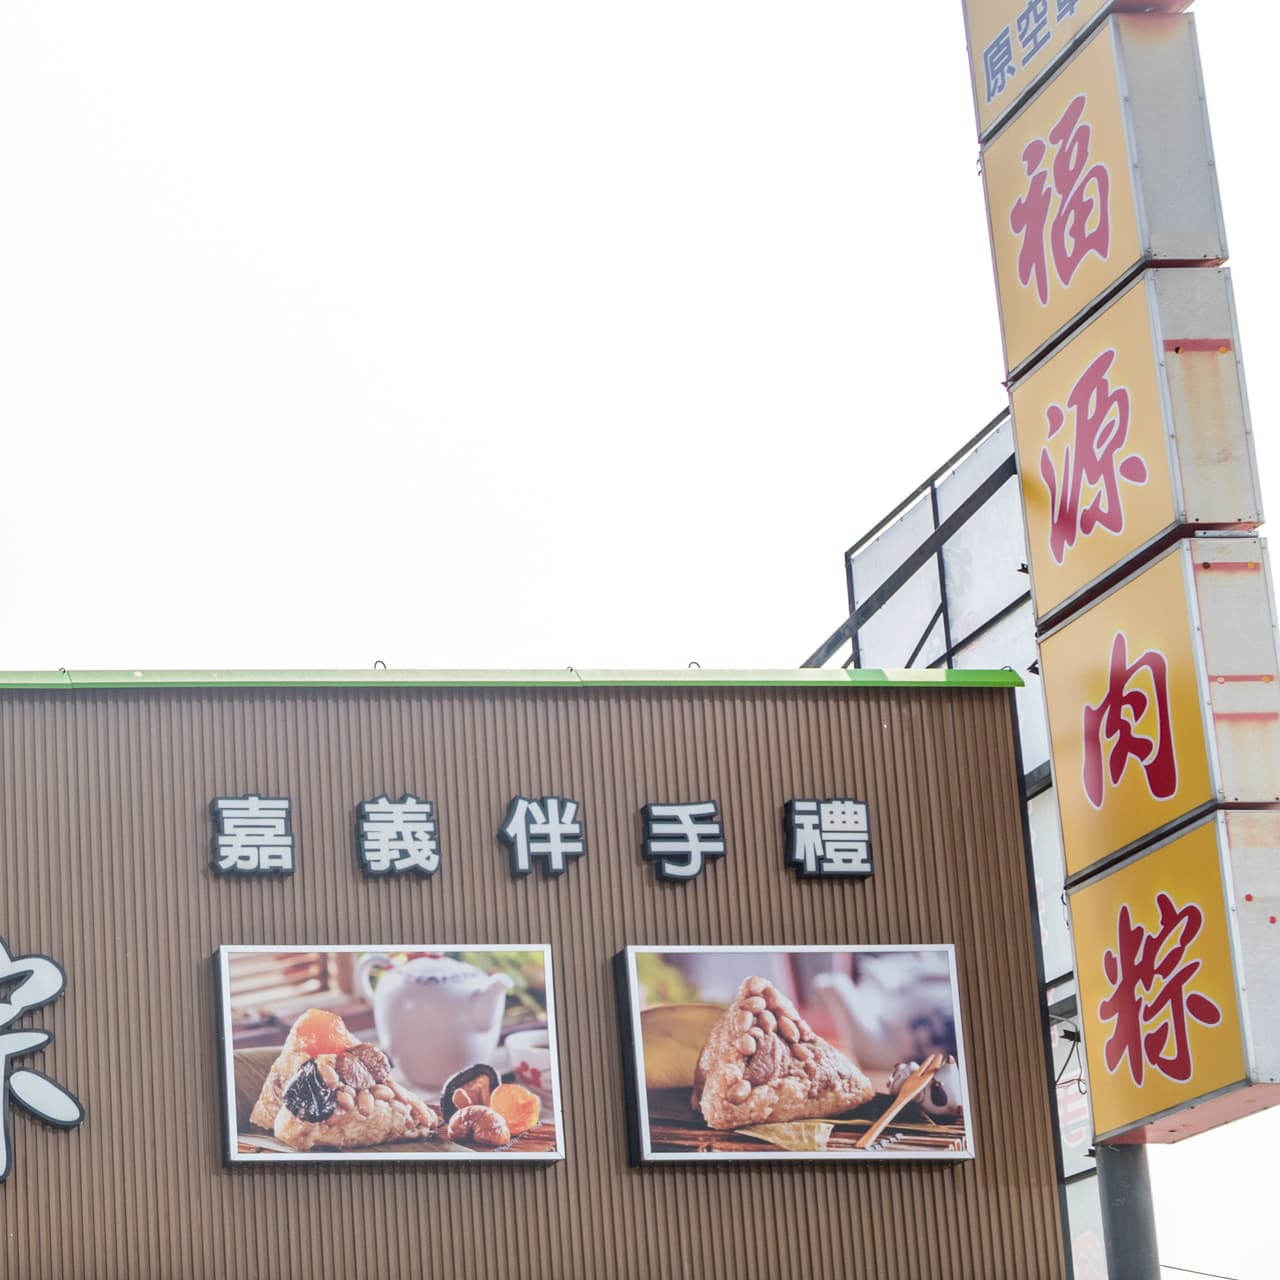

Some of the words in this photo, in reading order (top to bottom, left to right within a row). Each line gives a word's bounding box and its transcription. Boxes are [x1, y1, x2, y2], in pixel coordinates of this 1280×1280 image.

[982, 0, 1079, 104] 原空
[210, 794, 874, 881] 嘉義伴手禮
